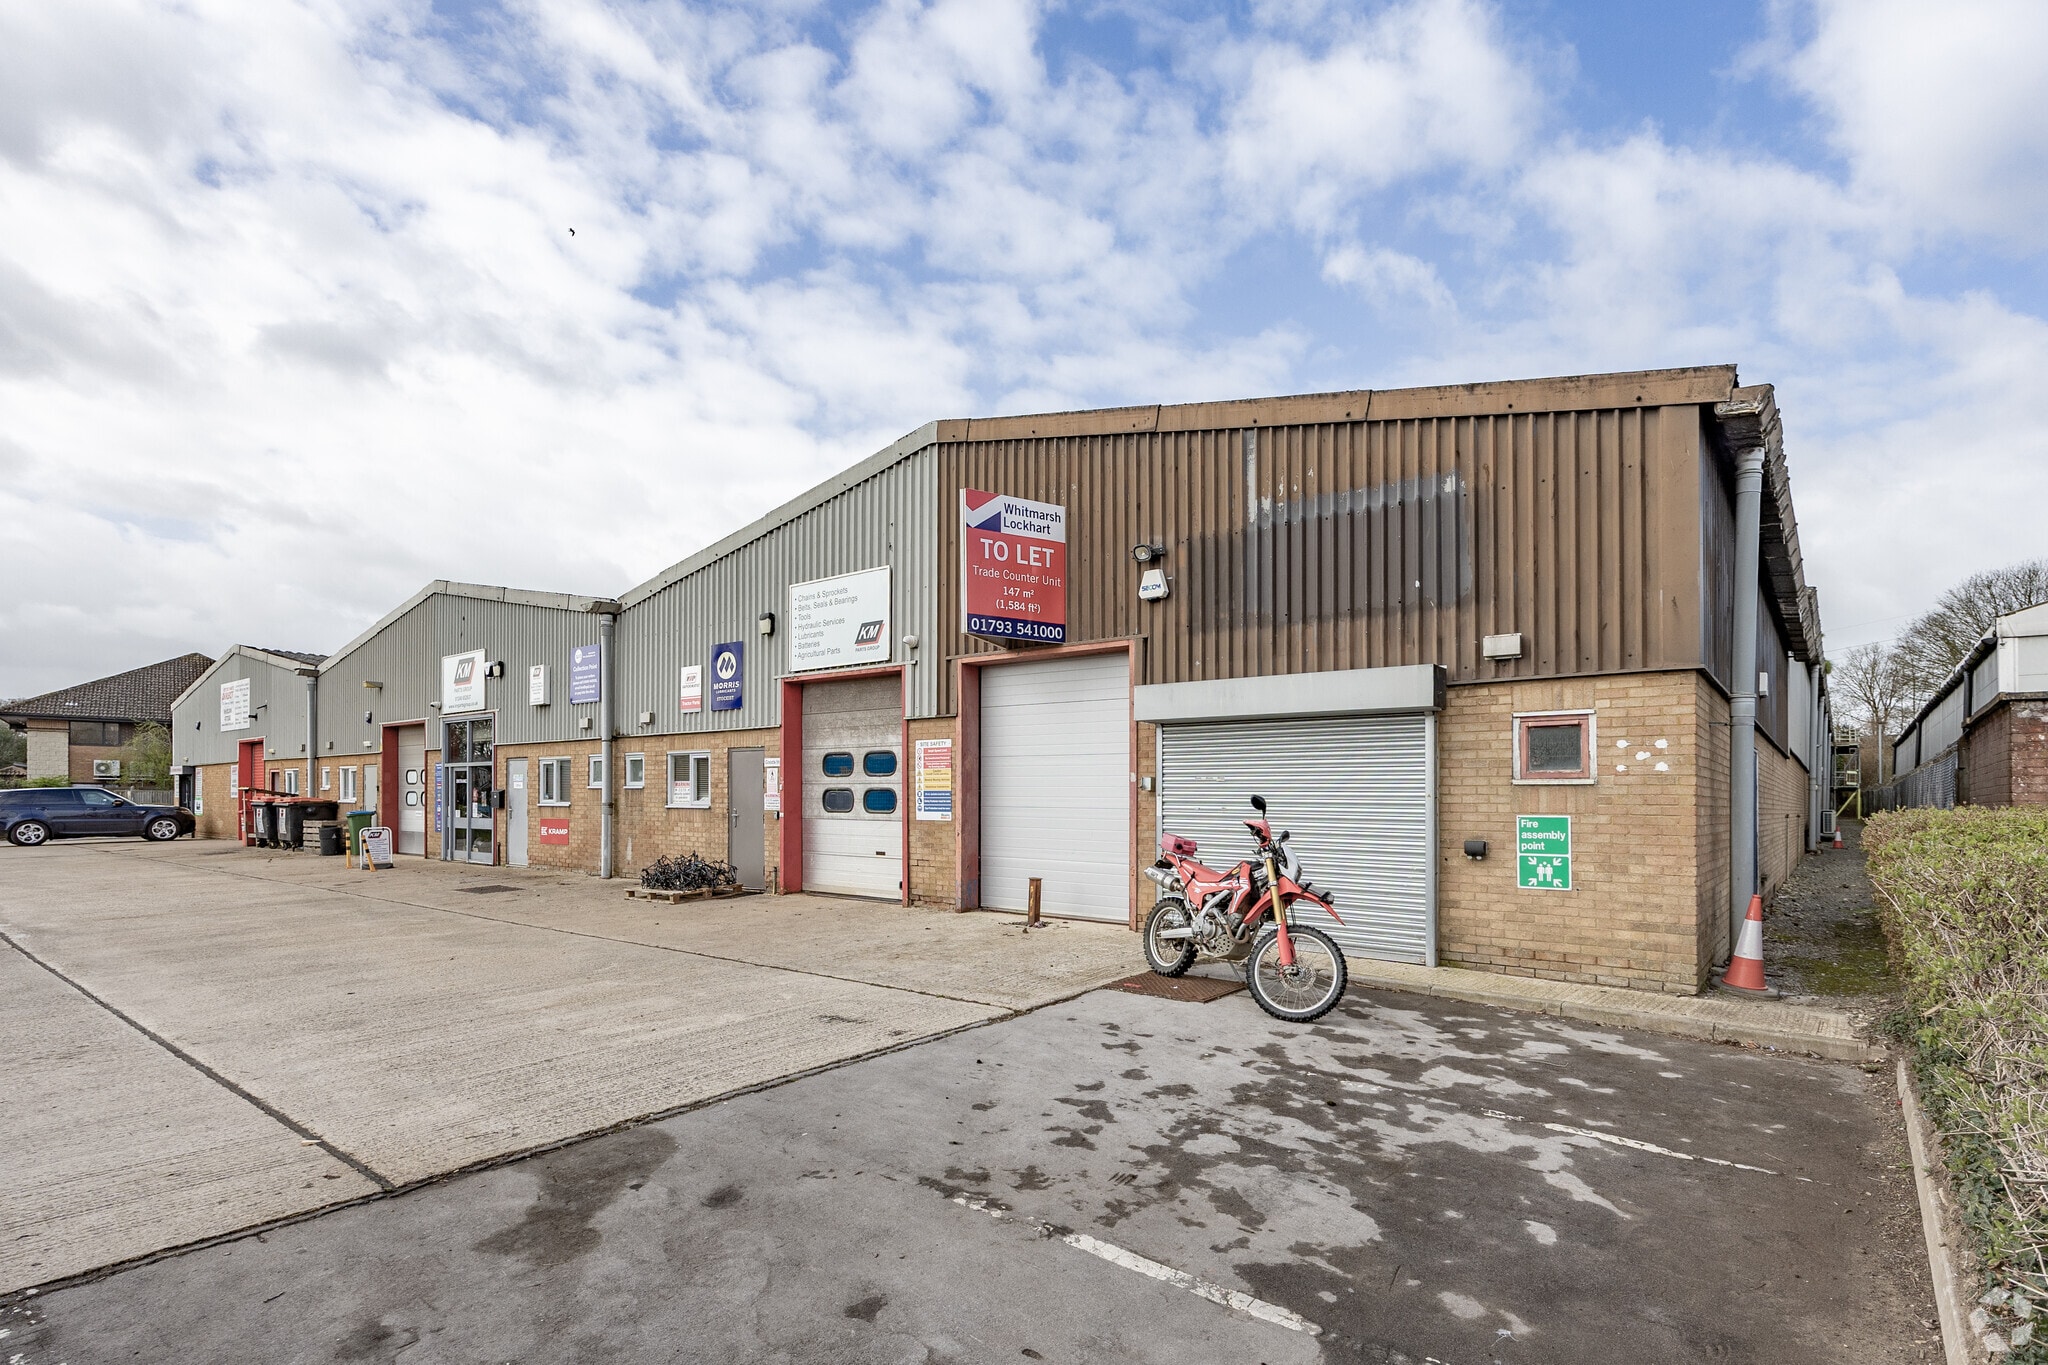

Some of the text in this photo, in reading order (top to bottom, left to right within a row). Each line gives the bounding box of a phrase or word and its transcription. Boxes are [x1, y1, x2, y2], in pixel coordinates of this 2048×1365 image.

[1004, 503, 1061, 523] Whitmarsh
[1004, 517, 1051, 534] Lockhart
[980, 538, 1055, 568] TO LET
[973, 565, 1061, 587] Trade Counter Unit
[798, 593, 815, 602] Chains
[822, 587, 848, 599] Sprockets
[1003, 586, 1021, 597] 147
[813, 601, 828, 609] Seals
[834, 595, 858, 606] Bearings
[996, 599, 1025, 611] (1,584
[798, 613, 812, 621] Tools
[798, 618, 845, 631] Hydraulic Services
[971, 618, 1063, 639] 01793 541000
[798, 630, 824, 640] Lubricants
[858, 625, 880, 640] KM
[798, 641, 820, 650] Batteries
[797, 647, 841, 660] Agricultural Parts
[456, 662, 472, 679] KM
[713, 681, 740, 690] MORRIS
[1521, 819, 1539, 828] Fire
[1521, 831, 1566, 841] assembly
[1521, 841, 1545, 851] point
